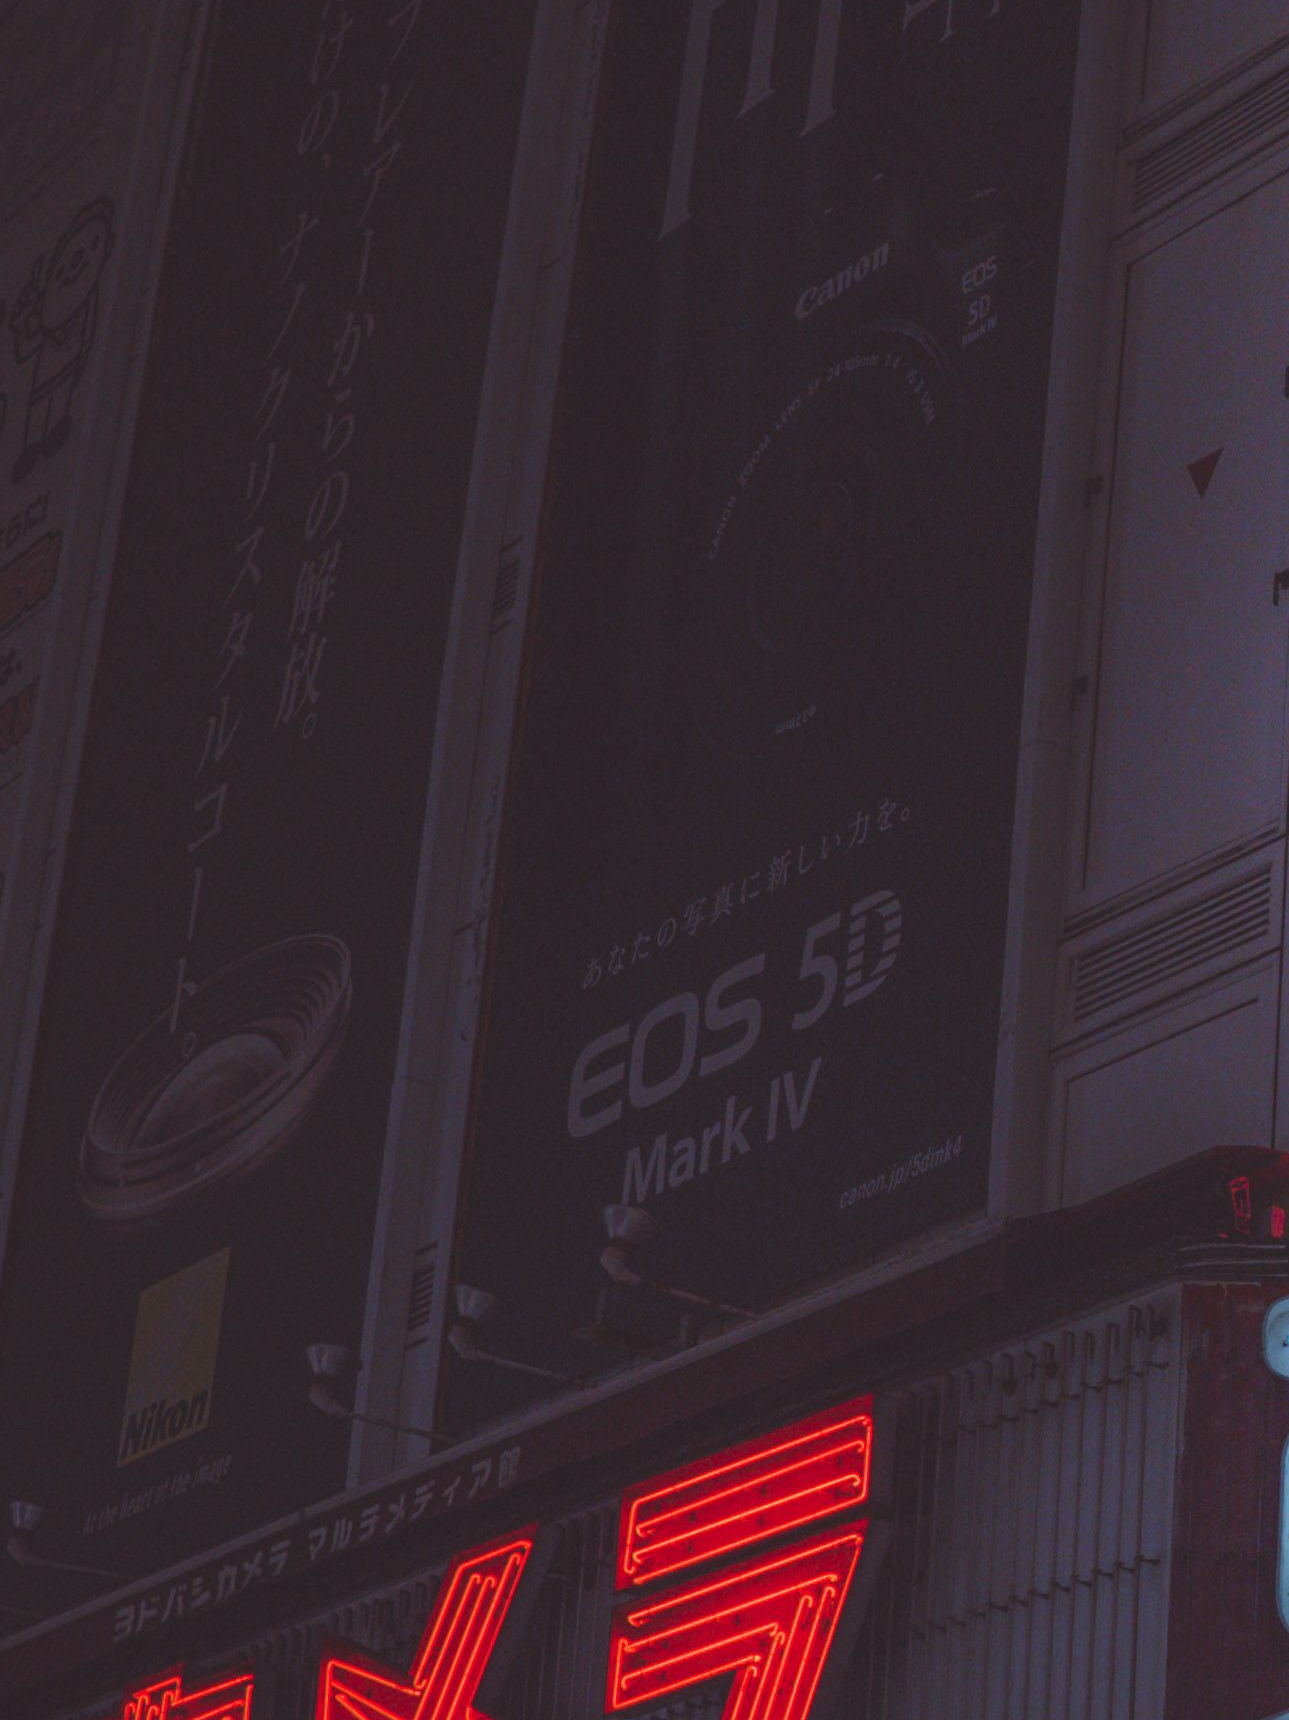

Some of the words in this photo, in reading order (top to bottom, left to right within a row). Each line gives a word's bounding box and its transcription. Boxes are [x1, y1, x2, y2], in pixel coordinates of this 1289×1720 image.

[795, 243, 888, 323] Canon
[960, 255, 999, 295] EOS
[565, 951, 770, 1143] EOS
[789, 886, 903, 1033] 5D
[620, 1092, 754, 1207] Mark
[765, 1055, 823, 1143] IV
[123, 1389, 209, 1459] Nikon
